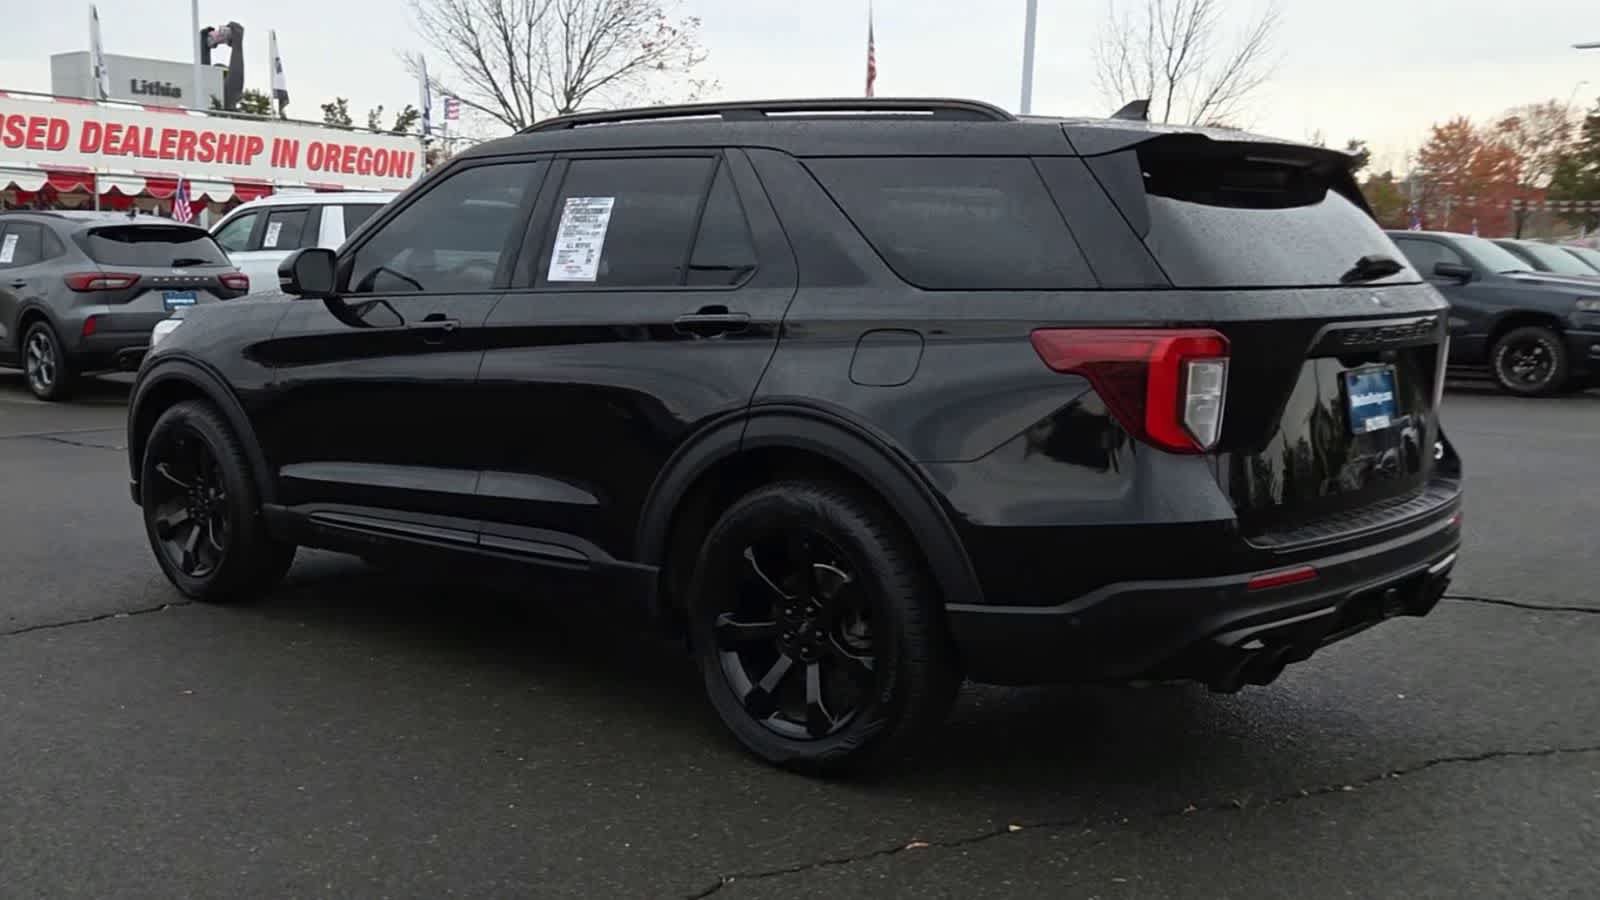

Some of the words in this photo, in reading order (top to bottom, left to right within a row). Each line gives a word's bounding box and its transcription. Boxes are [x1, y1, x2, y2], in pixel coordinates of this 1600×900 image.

[131, 78, 182, 98] Lithia
[0, 113, 70, 151] SED
[79, 120, 264, 166] DEALERSHIP
[271, 138, 300, 168] IN
[306, 142, 416, 178] OREGON!
